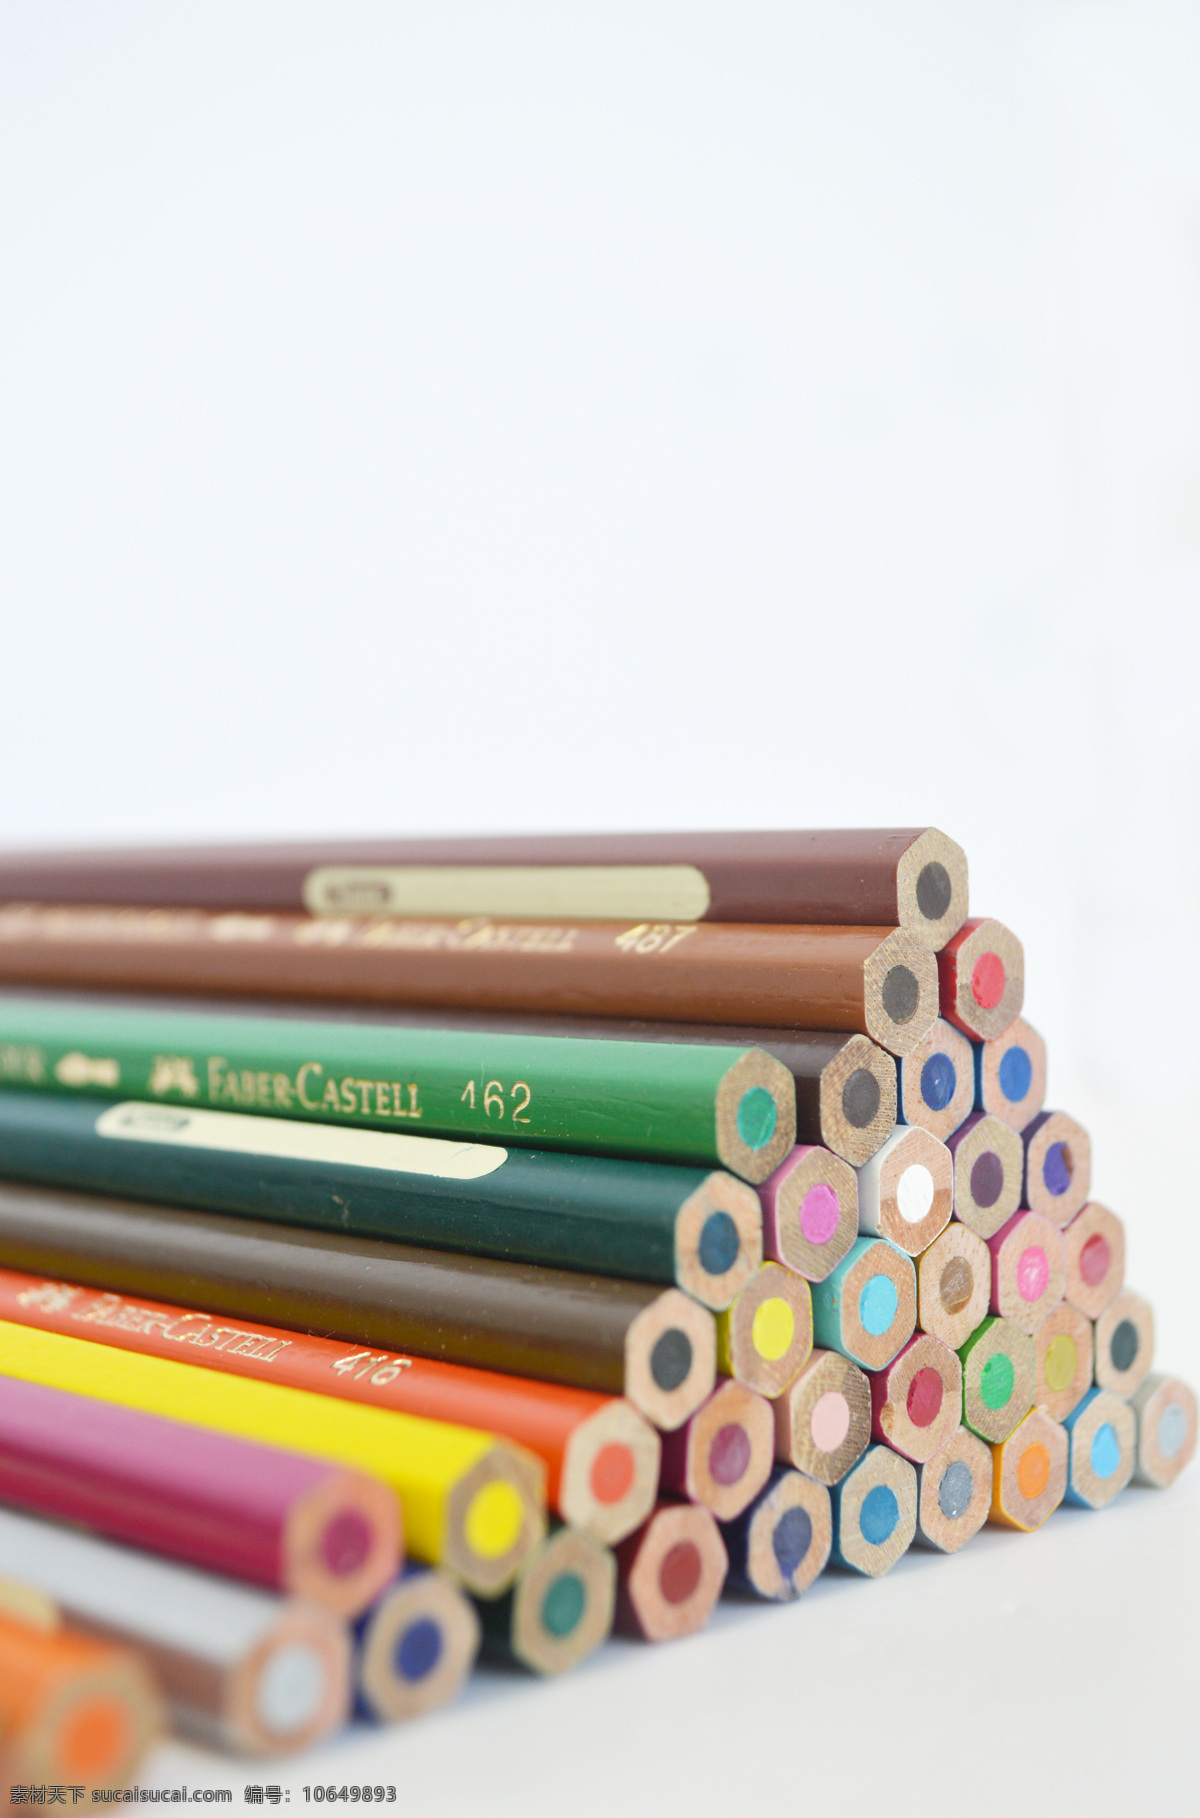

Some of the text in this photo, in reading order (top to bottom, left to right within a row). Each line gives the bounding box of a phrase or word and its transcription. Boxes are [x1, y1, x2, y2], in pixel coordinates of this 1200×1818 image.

[615, 924, 697, 953] 487
[206, 1055, 532, 1123] FABER-CASTELL 162
[330, 1351, 411, 1386] 416
